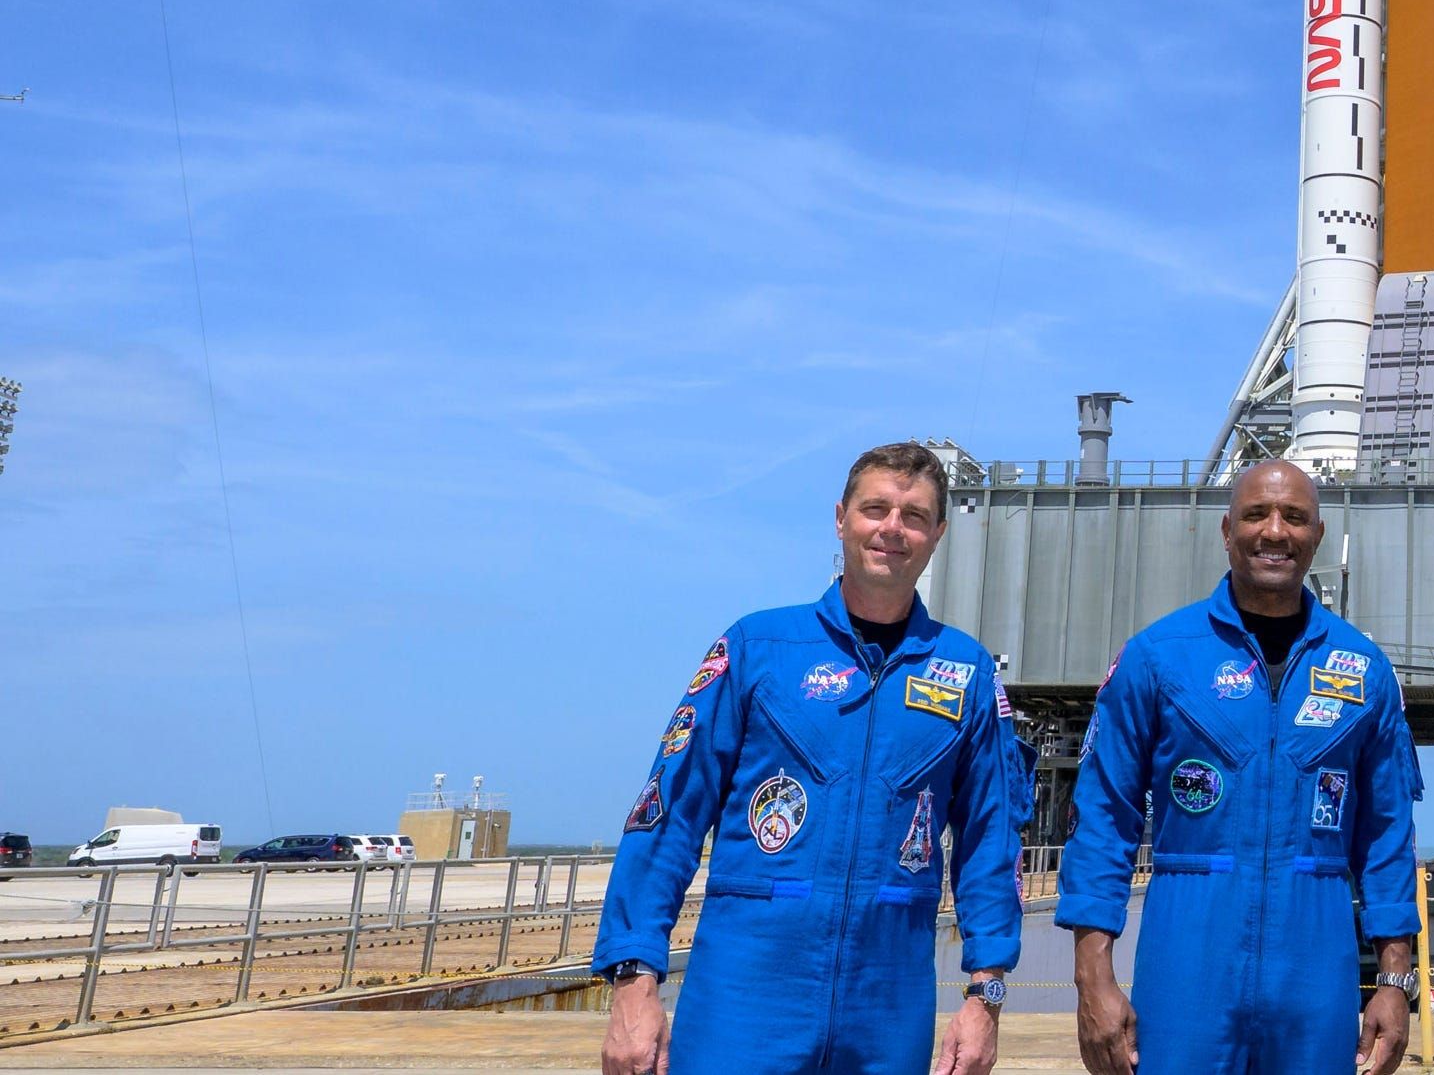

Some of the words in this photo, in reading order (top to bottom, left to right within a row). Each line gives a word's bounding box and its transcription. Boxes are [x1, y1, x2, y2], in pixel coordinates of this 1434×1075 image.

[807, 674, 849, 685] NASA
[1217, 674, 1252, 685] NASA
[763, 826, 784, 840] XL
